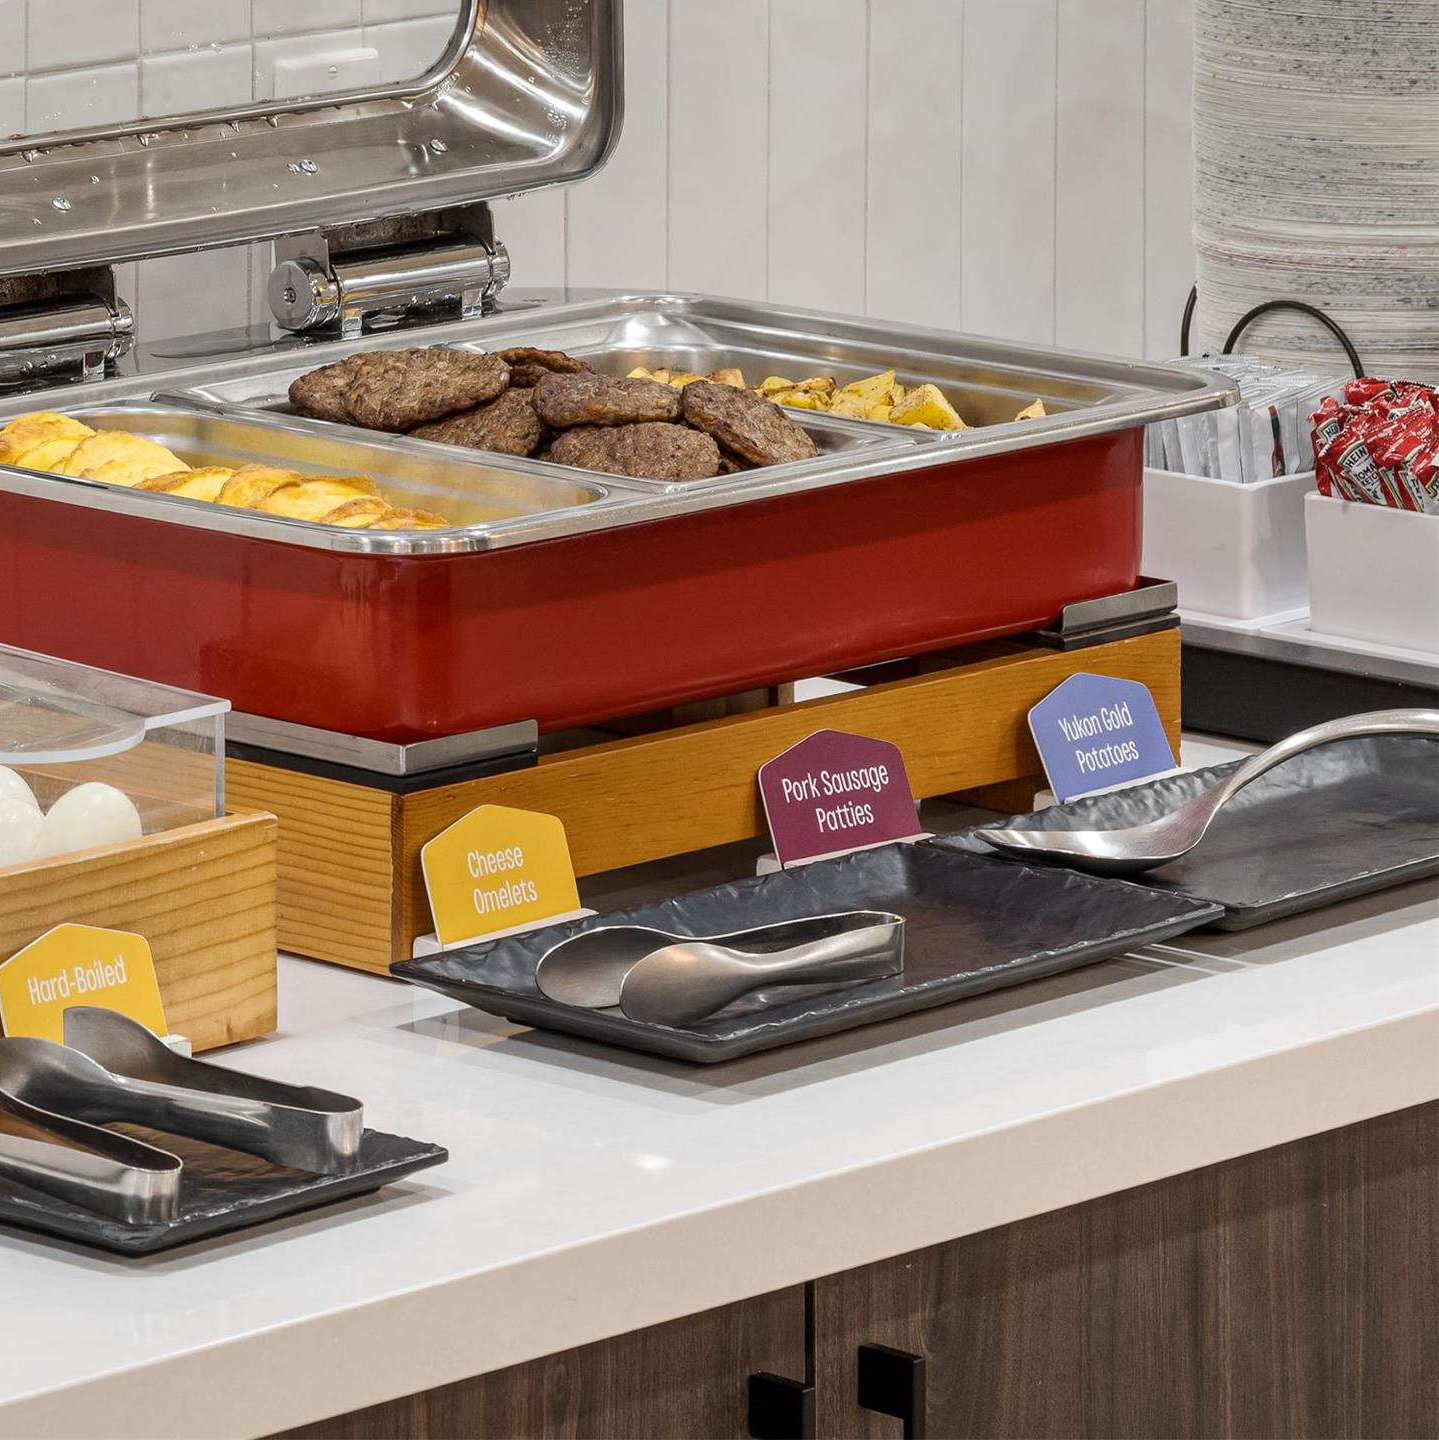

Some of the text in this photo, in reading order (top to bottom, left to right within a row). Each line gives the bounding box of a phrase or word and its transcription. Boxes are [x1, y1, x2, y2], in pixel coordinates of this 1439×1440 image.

[1345, 445, 1369, 469] HEIN
[1058, 701, 1133, 742] Yukon Gold
[1075, 740, 1140, 774] Potatoes
[781, 764, 889, 804] Pork Sausage
[815, 800, 875, 833] Patties
[467, 846, 524, 878] Cheese
[473, 879, 538, 914] Omelets
[27, 954, 128, 1006] Hard-Boiled
